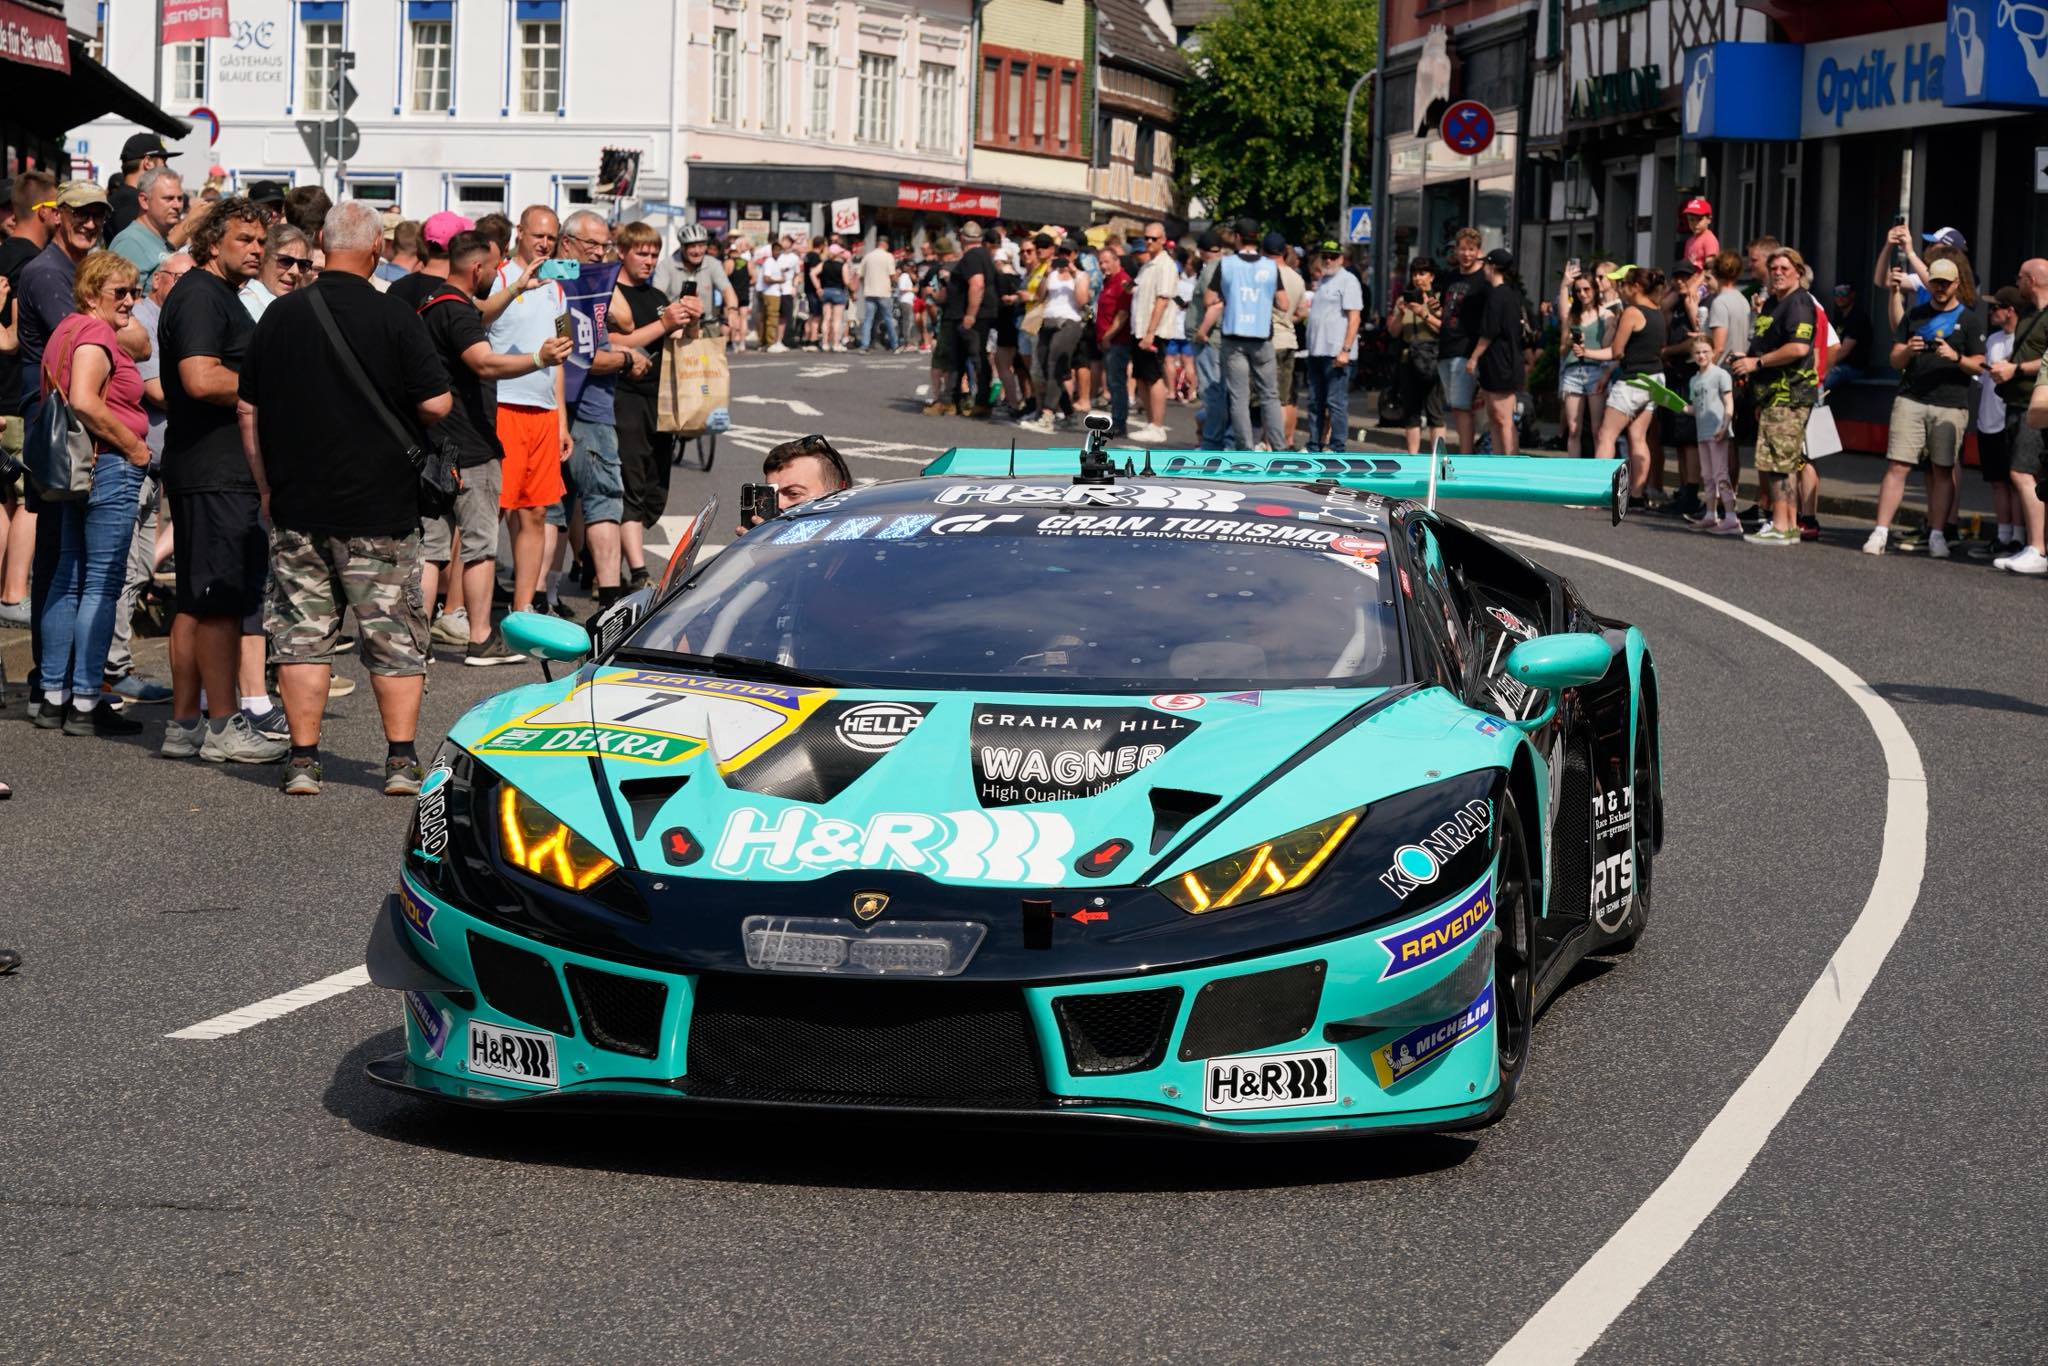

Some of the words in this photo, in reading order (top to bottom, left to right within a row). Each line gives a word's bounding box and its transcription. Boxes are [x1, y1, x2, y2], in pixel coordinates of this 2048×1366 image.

[219, 53, 283, 67] GÄSTEHAUS
[219, 71, 252, 82] BLAUE
[256, 71, 282, 82] ECKE
[1818, 49, 1898, 127] Optik
[1240, 287, 1260, 302] TV
[570, 307, 595, 358] ABT
[934, 484, 1127, 507] H&R
[1037, 515, 1161, 533] GRAN
[1161, 517, 1341, 543] TURISMO
[1037, 529, 1080, 537] THE
[1083, 530, 1131, 540] REAL
[1132, 531, 1203, 543] DRIVING
[1205, 535, 1327, 550] SIMULATOR
[639, 674, 791, 698] RAVENOL
[613, 692, 688, 721] 7
[978, 714, 1102, 730] GRAHAM
[1120, 719, 1185, 732] HILL
[541, 730, 670, 759] DEKRA
[981, 744, 1164, 785] WAGNER
[419, 755, 453, 858] KONRAD
[982, 783, 1019, 801] High
[1024, 787, 1080, 802] Quality
[1592, 795, 1604, 817] M
[1607, 790, 1618, 812] &
[712, 807, 948, 874] H&R
[1379, 799, 1494, 899] KONRAD
[1595, 849, 1632, 903] RTS
[1401, 895, 1490, 962] RAVENOL
[1416, 1000, 1489, 1055] MICHELIN
[471, 1027, 520, 1076] H&R
[1210, 1063, 1289, 1104] H&R
